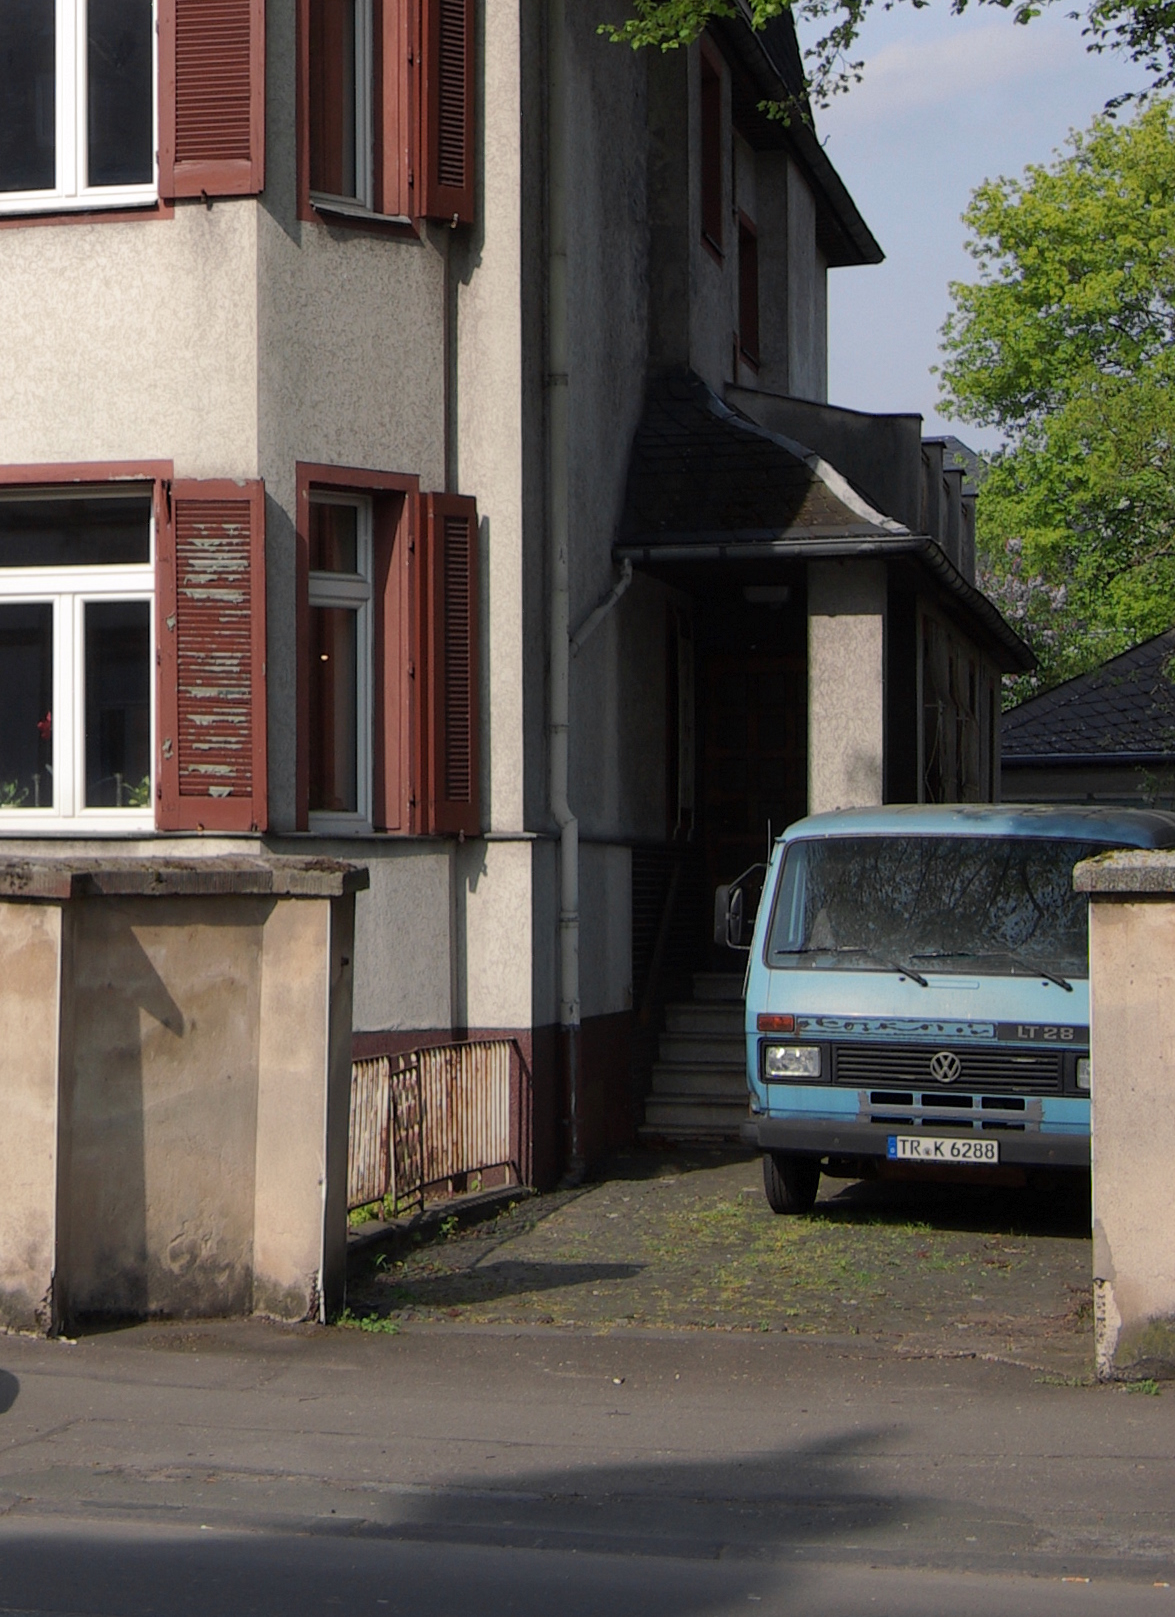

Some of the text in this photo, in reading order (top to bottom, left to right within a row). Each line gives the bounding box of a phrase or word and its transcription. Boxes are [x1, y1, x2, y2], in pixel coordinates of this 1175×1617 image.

[1017, 1025, 1074, 1040] LT 28
[899, 1139, 995, 1159] TR K 6288
